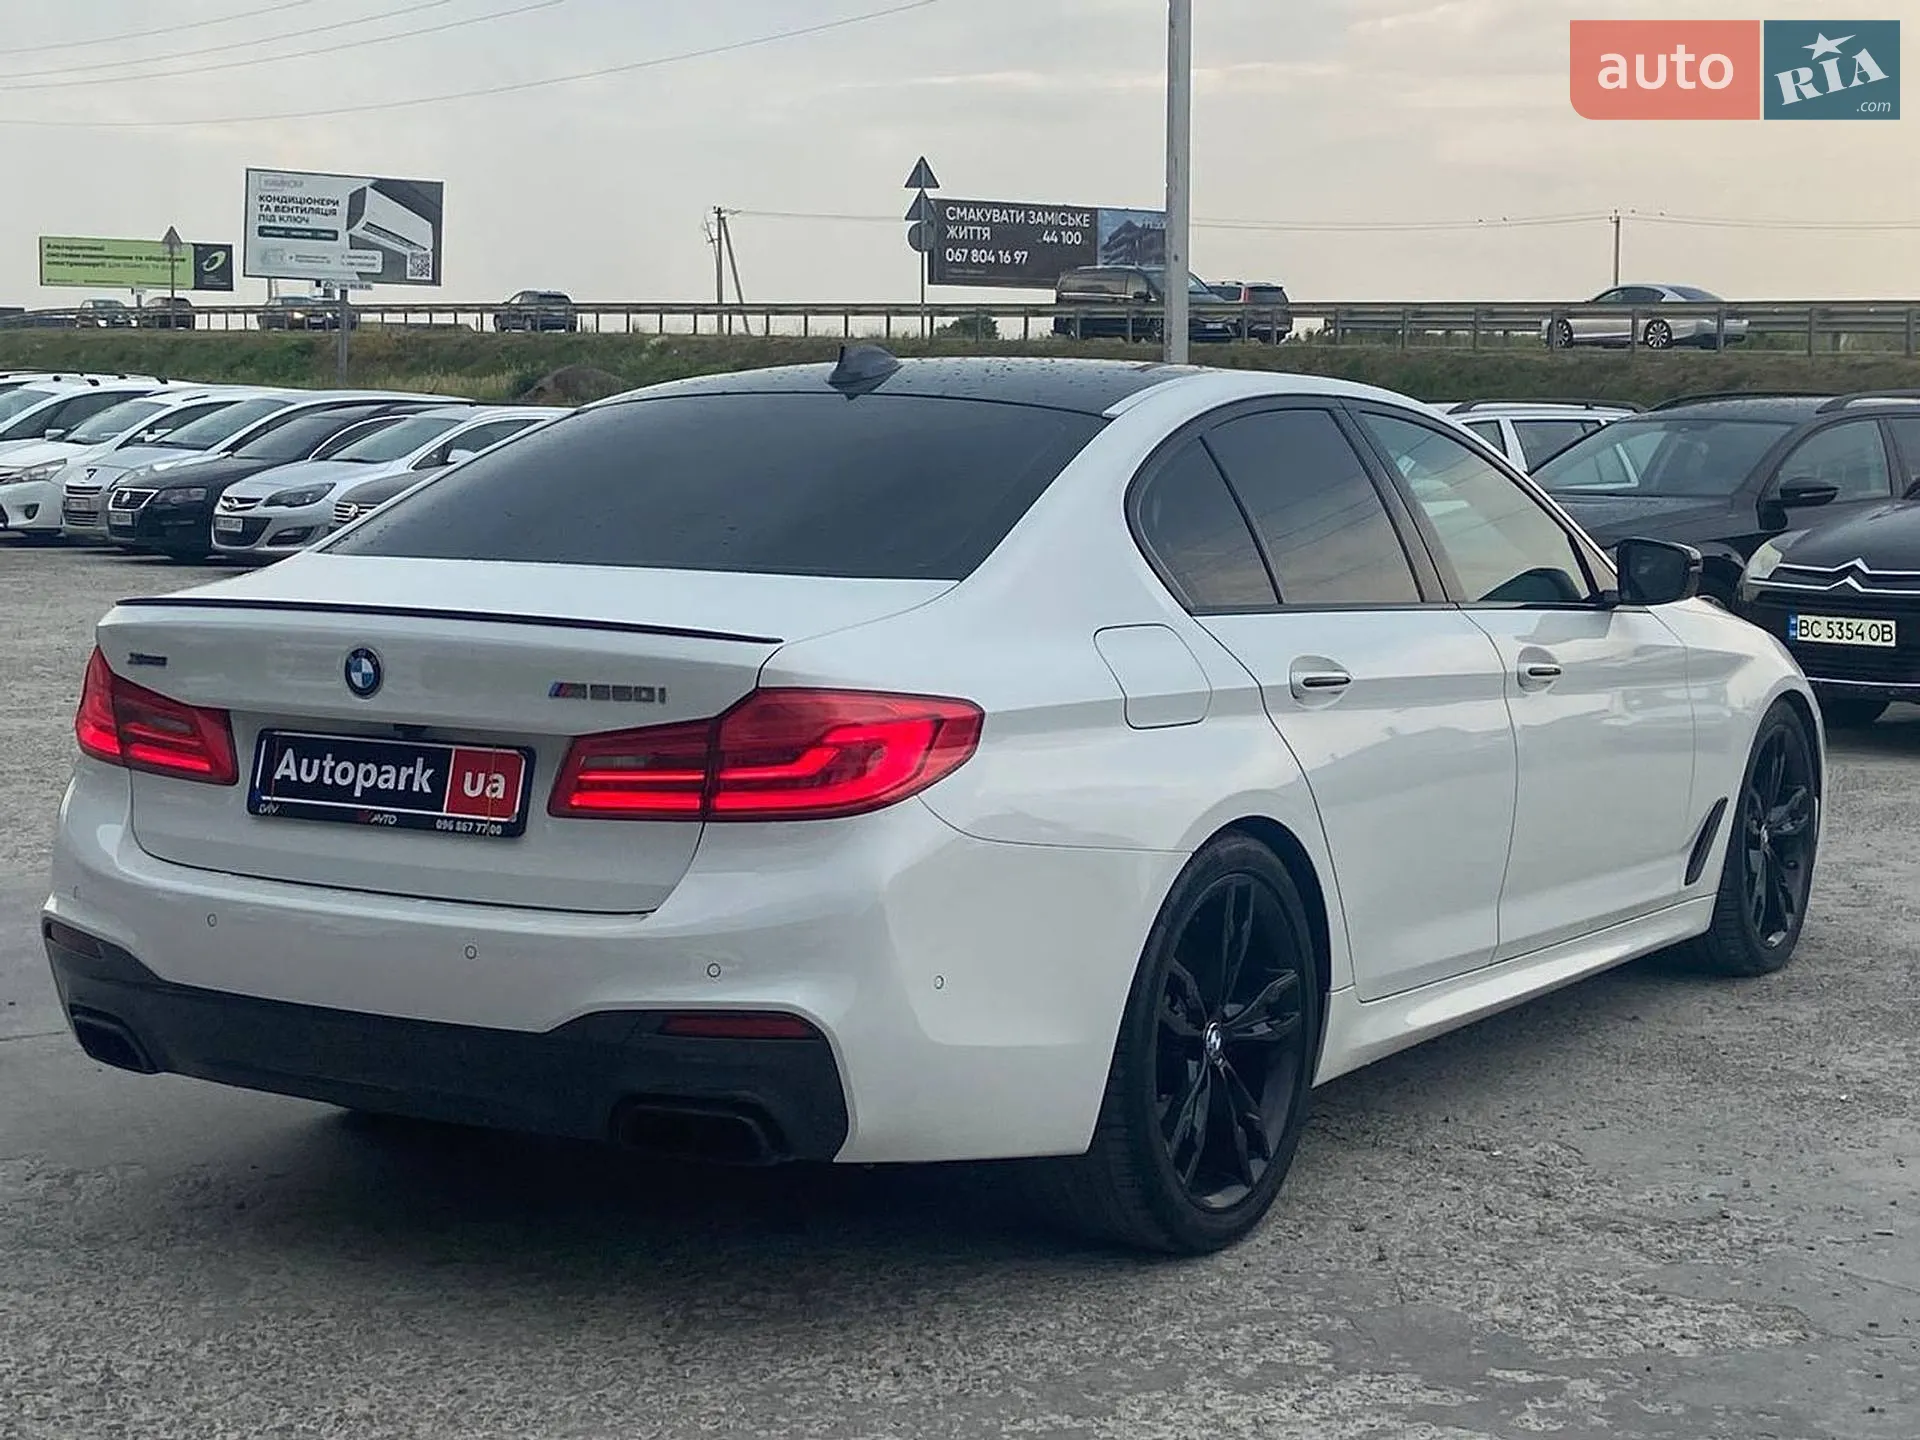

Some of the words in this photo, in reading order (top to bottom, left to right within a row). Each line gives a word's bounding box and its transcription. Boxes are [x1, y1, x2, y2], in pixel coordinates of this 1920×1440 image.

[946, 206, 1024, 224] СМАКУВАТИ
[1028, 210, 1090, 228] ЗАМІСЬКЕ
[946, 224, 991, 241] ЖИТТЯ
[1043, 230, 1058, 243] 44
[1061, 231, 1082, 245] 100
[946, 248, 967, 262] 067
[971, 249, 995, 263] 804
[999, 250, 1011, 264] 16
[1014, 251, 1028, 265] 97
[1799, 619, 1821, 638] BC
[1826, 621, 1865, 641] 5354
[1868, 623, 1894, 642] OB
[274, 748, 436, 797] Autopark
[463, 770, 506, 799] ua
